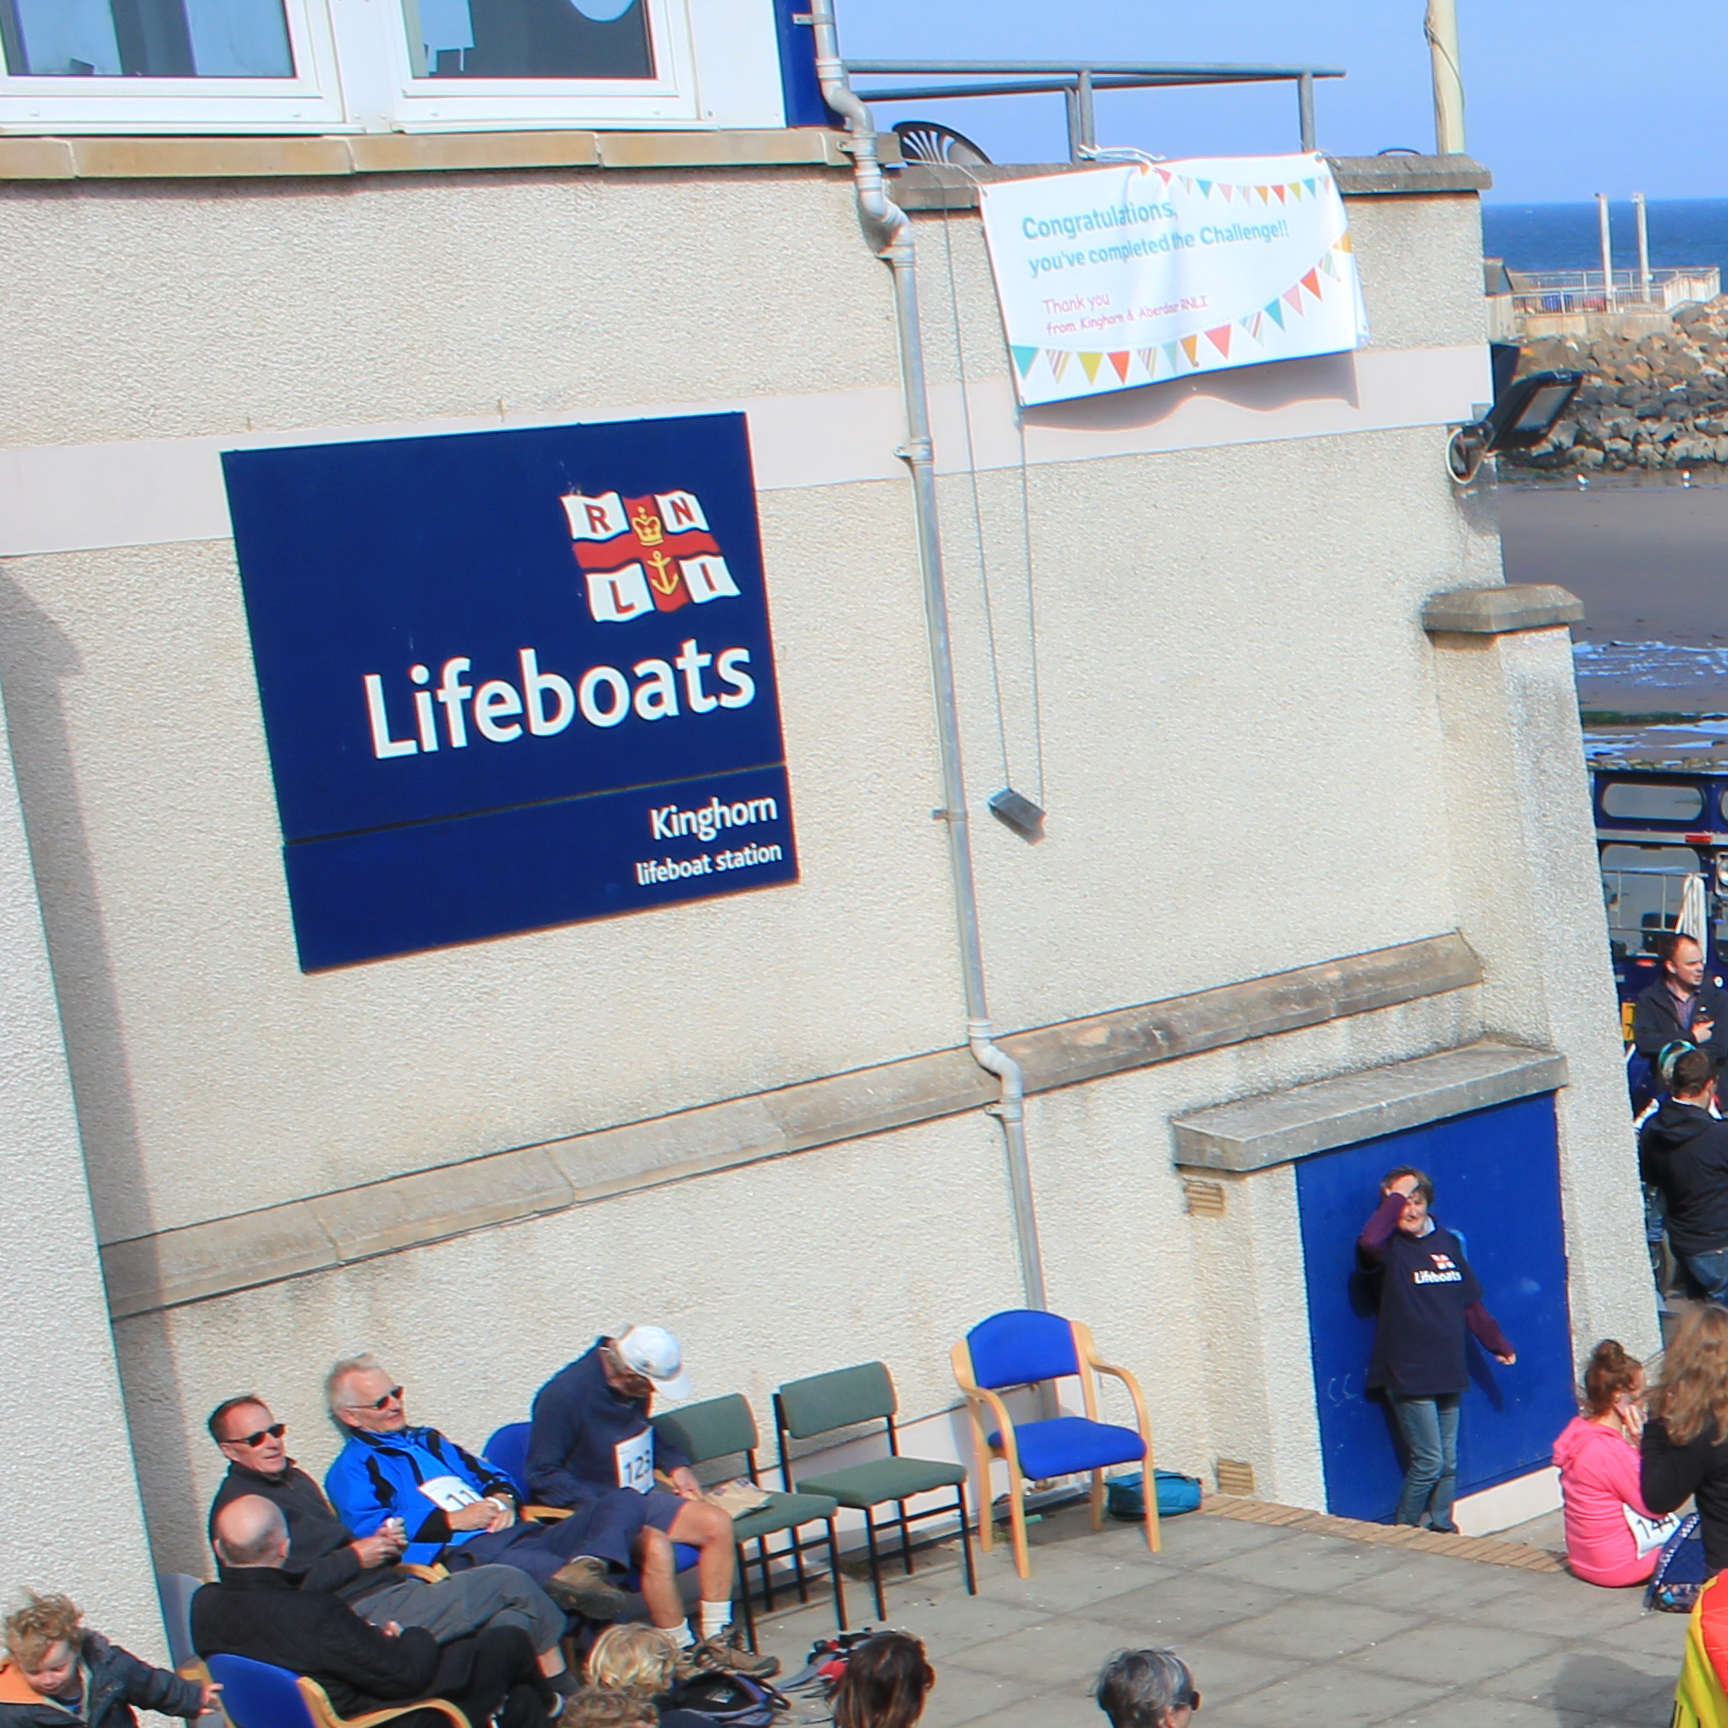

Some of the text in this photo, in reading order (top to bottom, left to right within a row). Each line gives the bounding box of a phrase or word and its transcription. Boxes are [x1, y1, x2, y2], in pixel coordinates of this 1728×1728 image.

[1022, 201, 1179, 240] Congratulations,
[1028, 219, 1290, 279] you've completed the Challenge!!
[1041, 292, 1111, 315] Thank you
[1046, 321, 1077, 336] from
[1079, 312, 1125, 331] Kinghorn
[363, 636, 756, 760] Lifeboats
[650, 796, 779, 842] Kinghorn
[635, 842, 783, 886] lifeboat station
